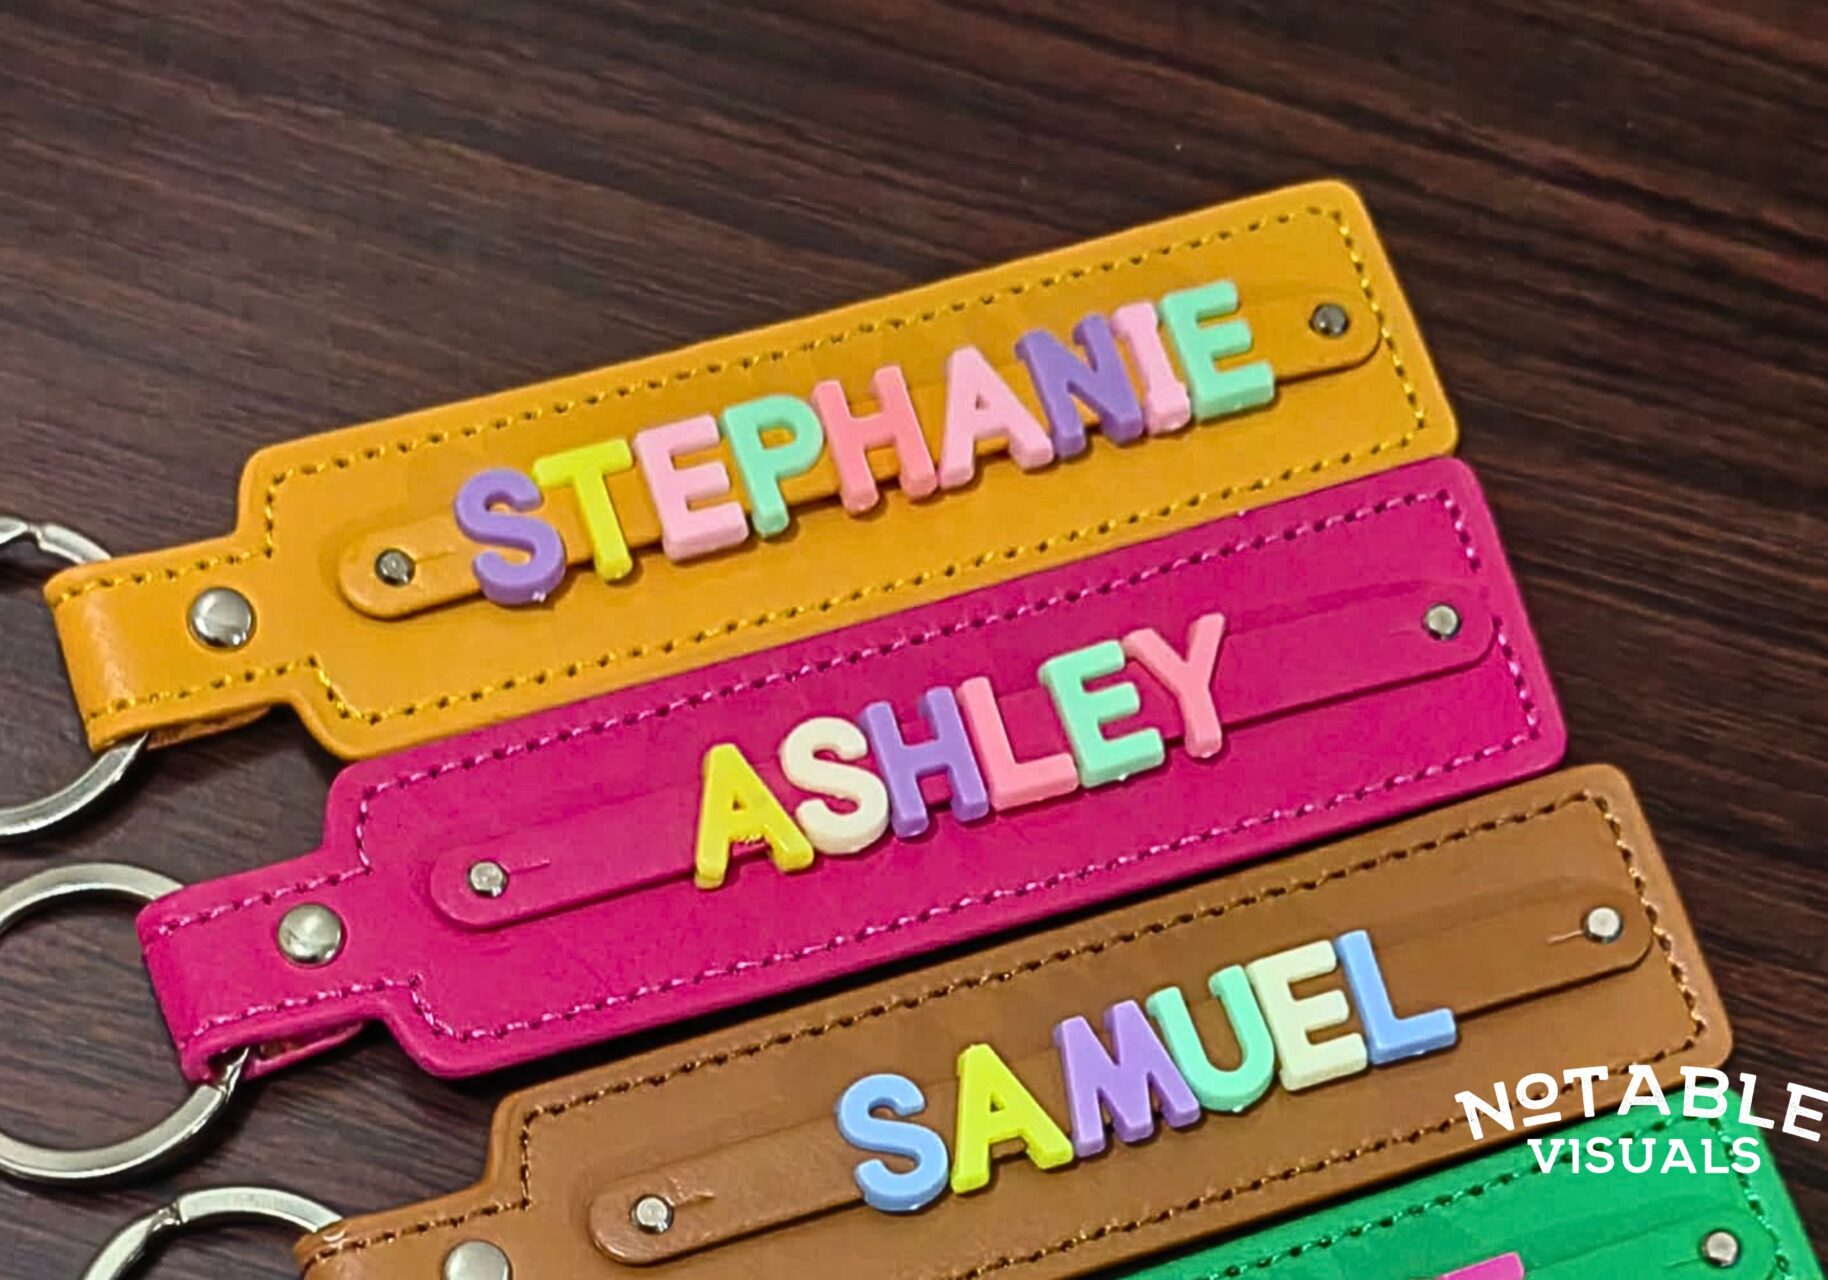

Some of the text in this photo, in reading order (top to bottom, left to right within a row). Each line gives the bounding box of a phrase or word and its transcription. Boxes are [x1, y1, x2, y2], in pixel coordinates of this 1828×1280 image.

[456, 279, 1276, 609] STEPHANIE
[696, 612, 1226, 890] ASHLEY
[837, 929, 1457, 1213] SAMUEL
